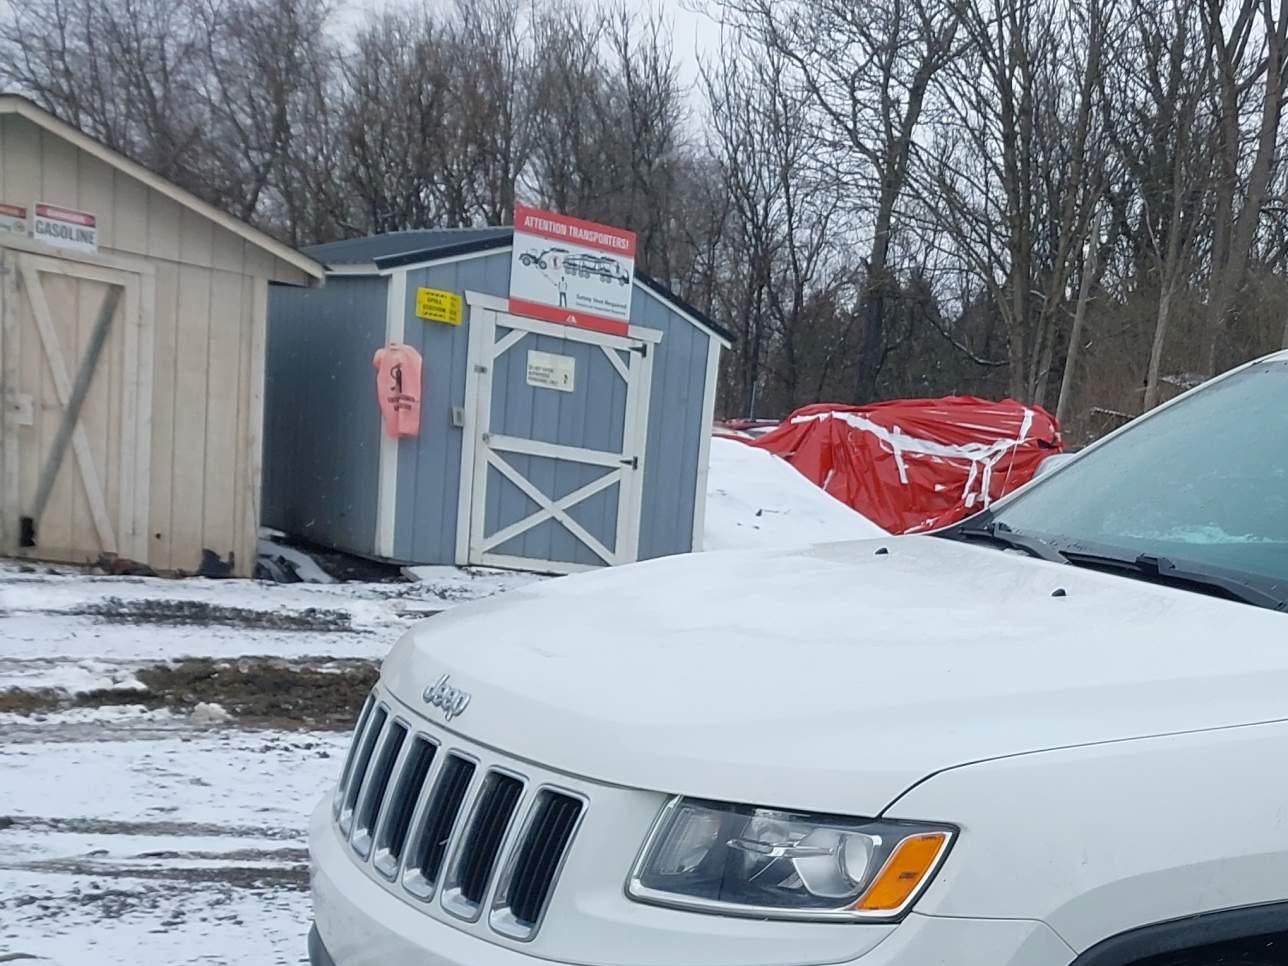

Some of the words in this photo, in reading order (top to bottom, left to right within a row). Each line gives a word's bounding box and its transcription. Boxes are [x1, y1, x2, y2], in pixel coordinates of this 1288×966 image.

[35, 219, 96, 245] GASOLINE
[524, 215, 567, 236] ATTENTION
[568, 225, 629, 249] TRANSPORTERS!
[422, 673, 472, 722] Jeep
